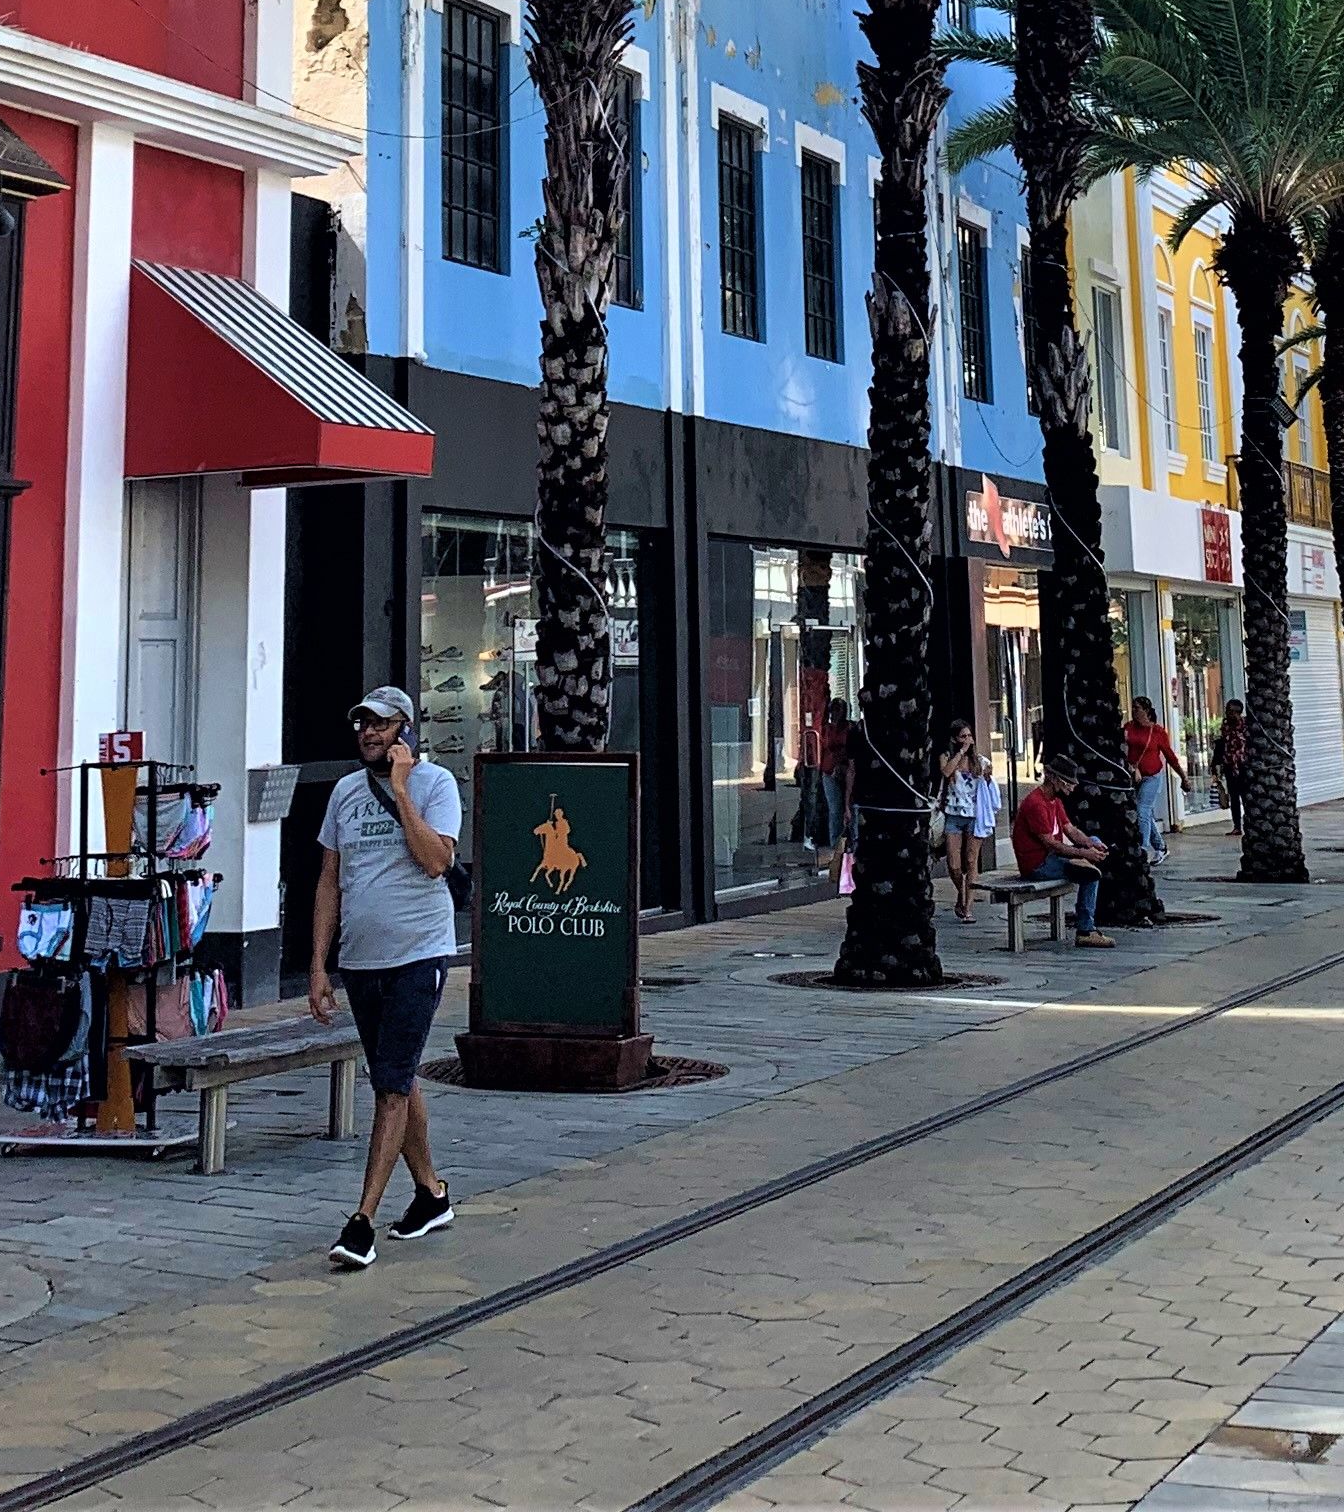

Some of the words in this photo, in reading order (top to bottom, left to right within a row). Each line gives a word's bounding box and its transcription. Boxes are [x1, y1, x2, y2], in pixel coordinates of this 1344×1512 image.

[967, 500, 988, 532] the
[1002, 506, 1046, 540] athlete's
[112, 733, 131, 763] 5
[488, 890, 525, 916] Royal
[525, 893, 560, 917] County
[561, 898, 573, 913] of
[569, 895, 621, 916] Berkshire
[508, 915, 554, 934] POLO
[560, 917, 605, 937] CLUB
